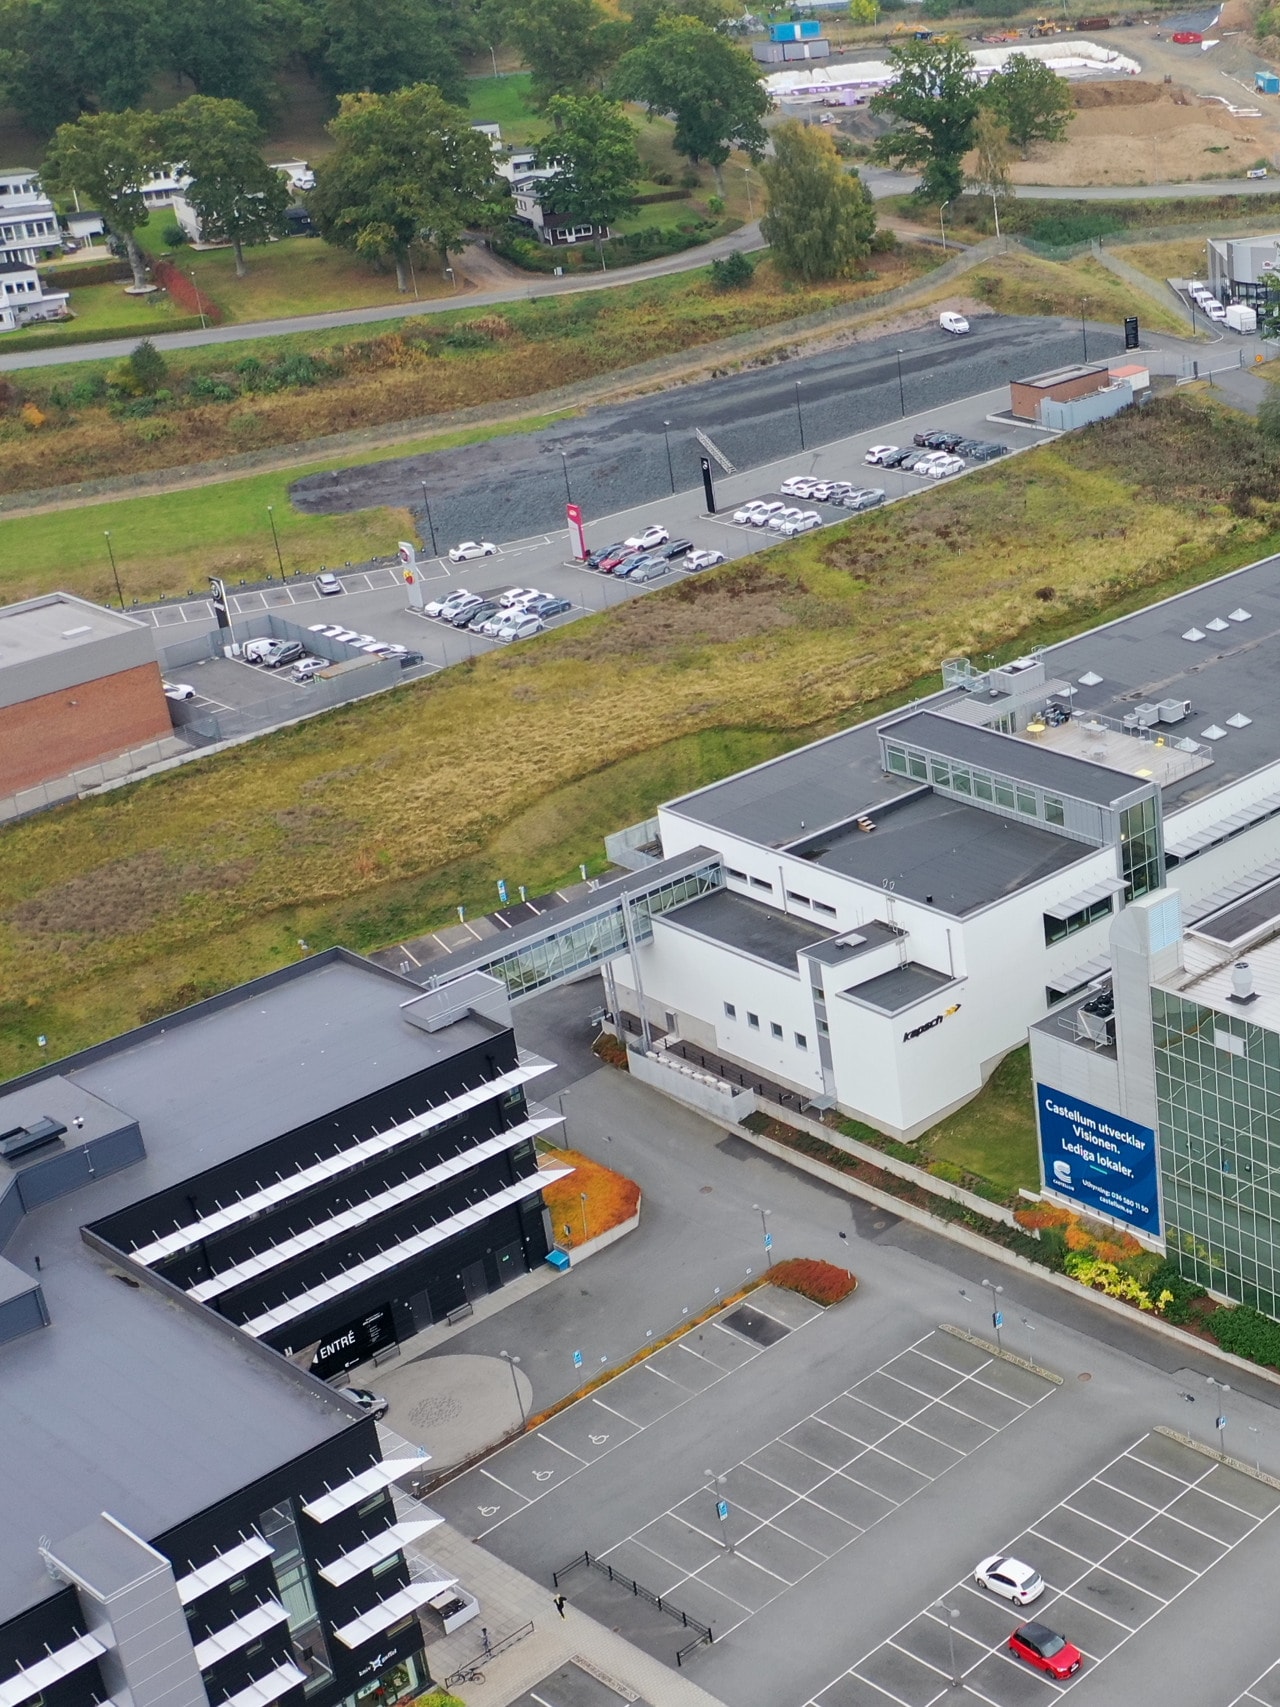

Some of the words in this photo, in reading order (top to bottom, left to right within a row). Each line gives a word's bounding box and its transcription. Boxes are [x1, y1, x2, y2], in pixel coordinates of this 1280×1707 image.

[903, 1015, 943, 1043] kapsch
[1045, 1099, 1096, 1130] Castellum
[1098, 1123, 1146, 1151] utvecklar
[1073, 1124, 1121, 1155] Visionen.
[1062, 1138, 1095, 1161] Lediga
[1097, 1152, 1134, 1179] lokaler.
[319, 1329, 356, 1359] ENTRÉ
